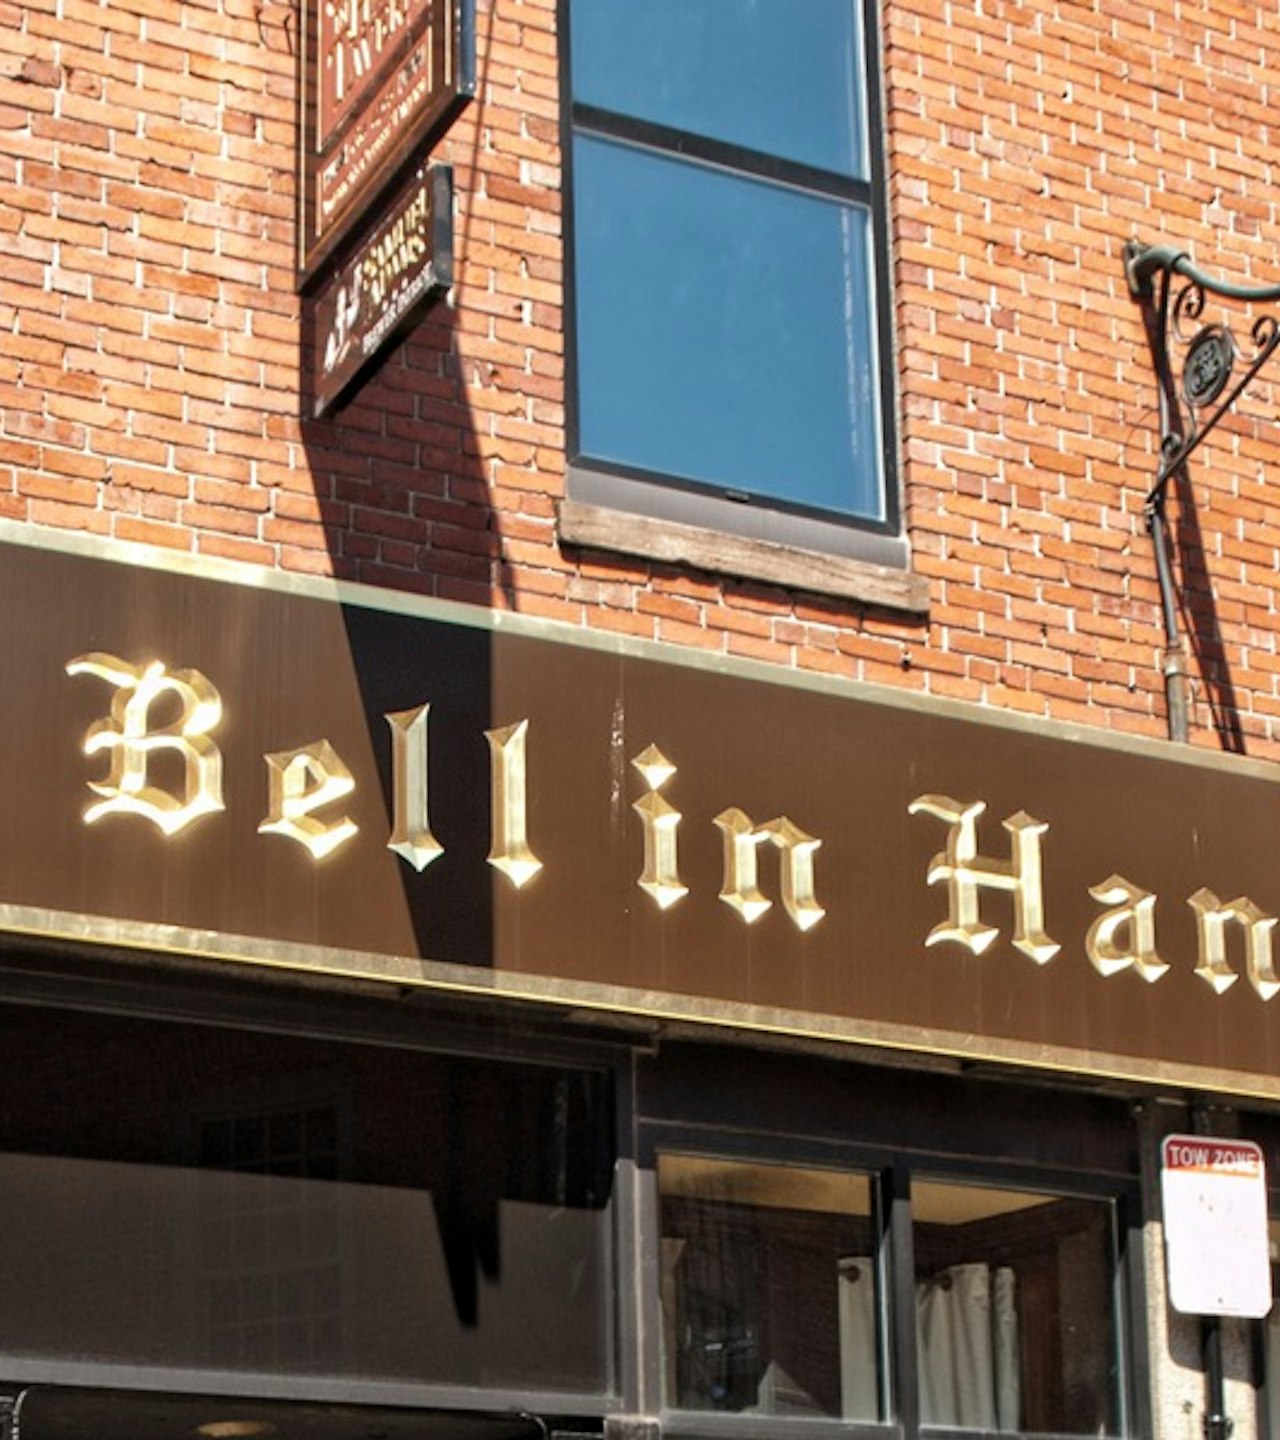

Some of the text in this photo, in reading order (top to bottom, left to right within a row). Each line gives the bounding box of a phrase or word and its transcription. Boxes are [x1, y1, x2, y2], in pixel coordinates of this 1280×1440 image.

[66, 651, 542, 888] Bell
[631, 743, 825, 932] in
[1169, 1145, 1258, 1166] TOW ZONE
